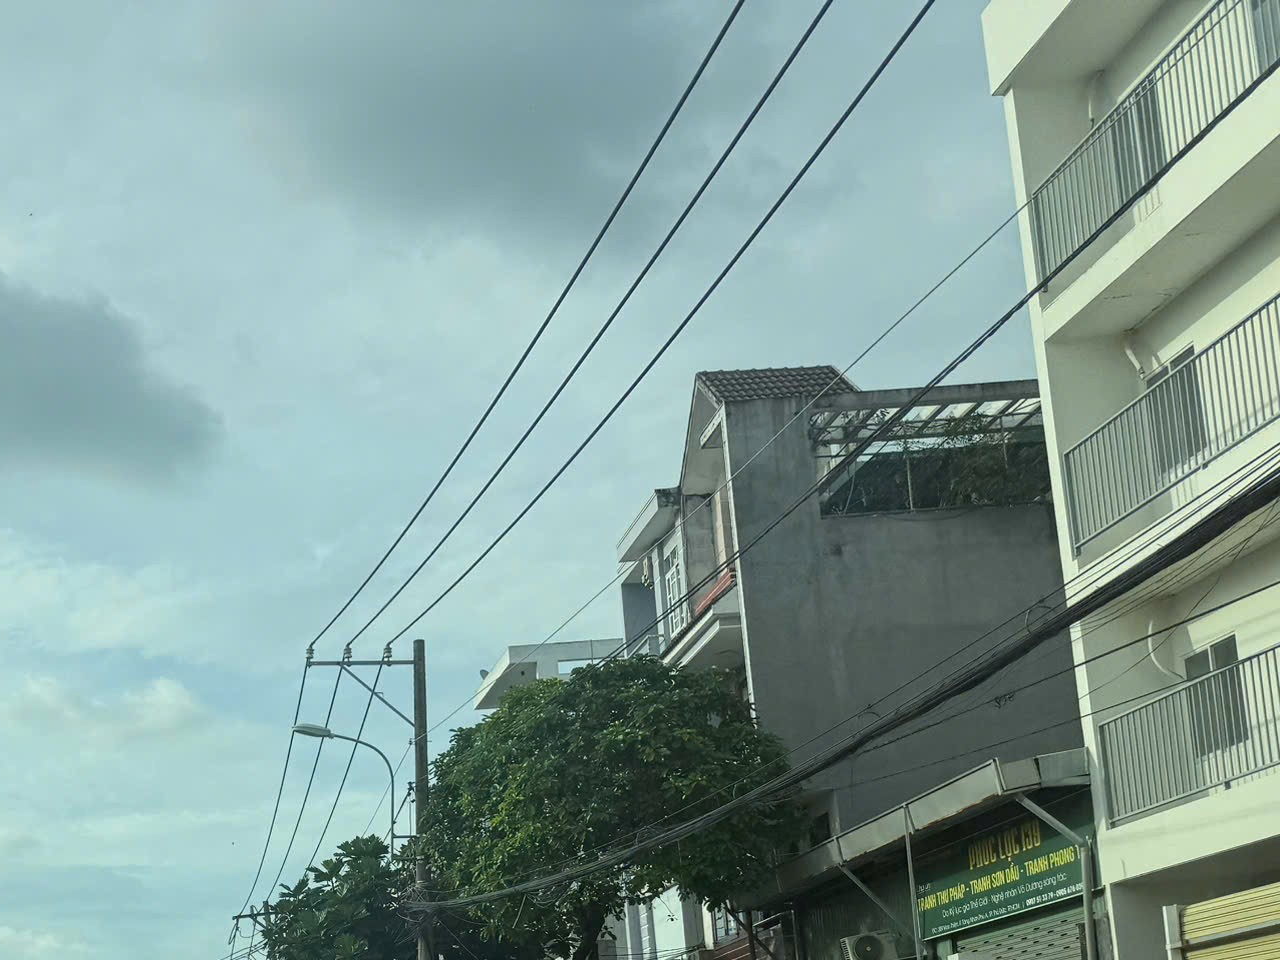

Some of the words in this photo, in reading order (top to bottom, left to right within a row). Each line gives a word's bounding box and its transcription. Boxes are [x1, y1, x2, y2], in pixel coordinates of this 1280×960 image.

[917, 893, 938, 912] TRANH
[949, 882, 965, 902] PHÁP
[970, 874, 991, 894] TRANH
[991, 868, 1005, 888] SƠN
[1024, 855, 1049, 876] TRANH
[1049, 846, 1075, 868] PHONG
